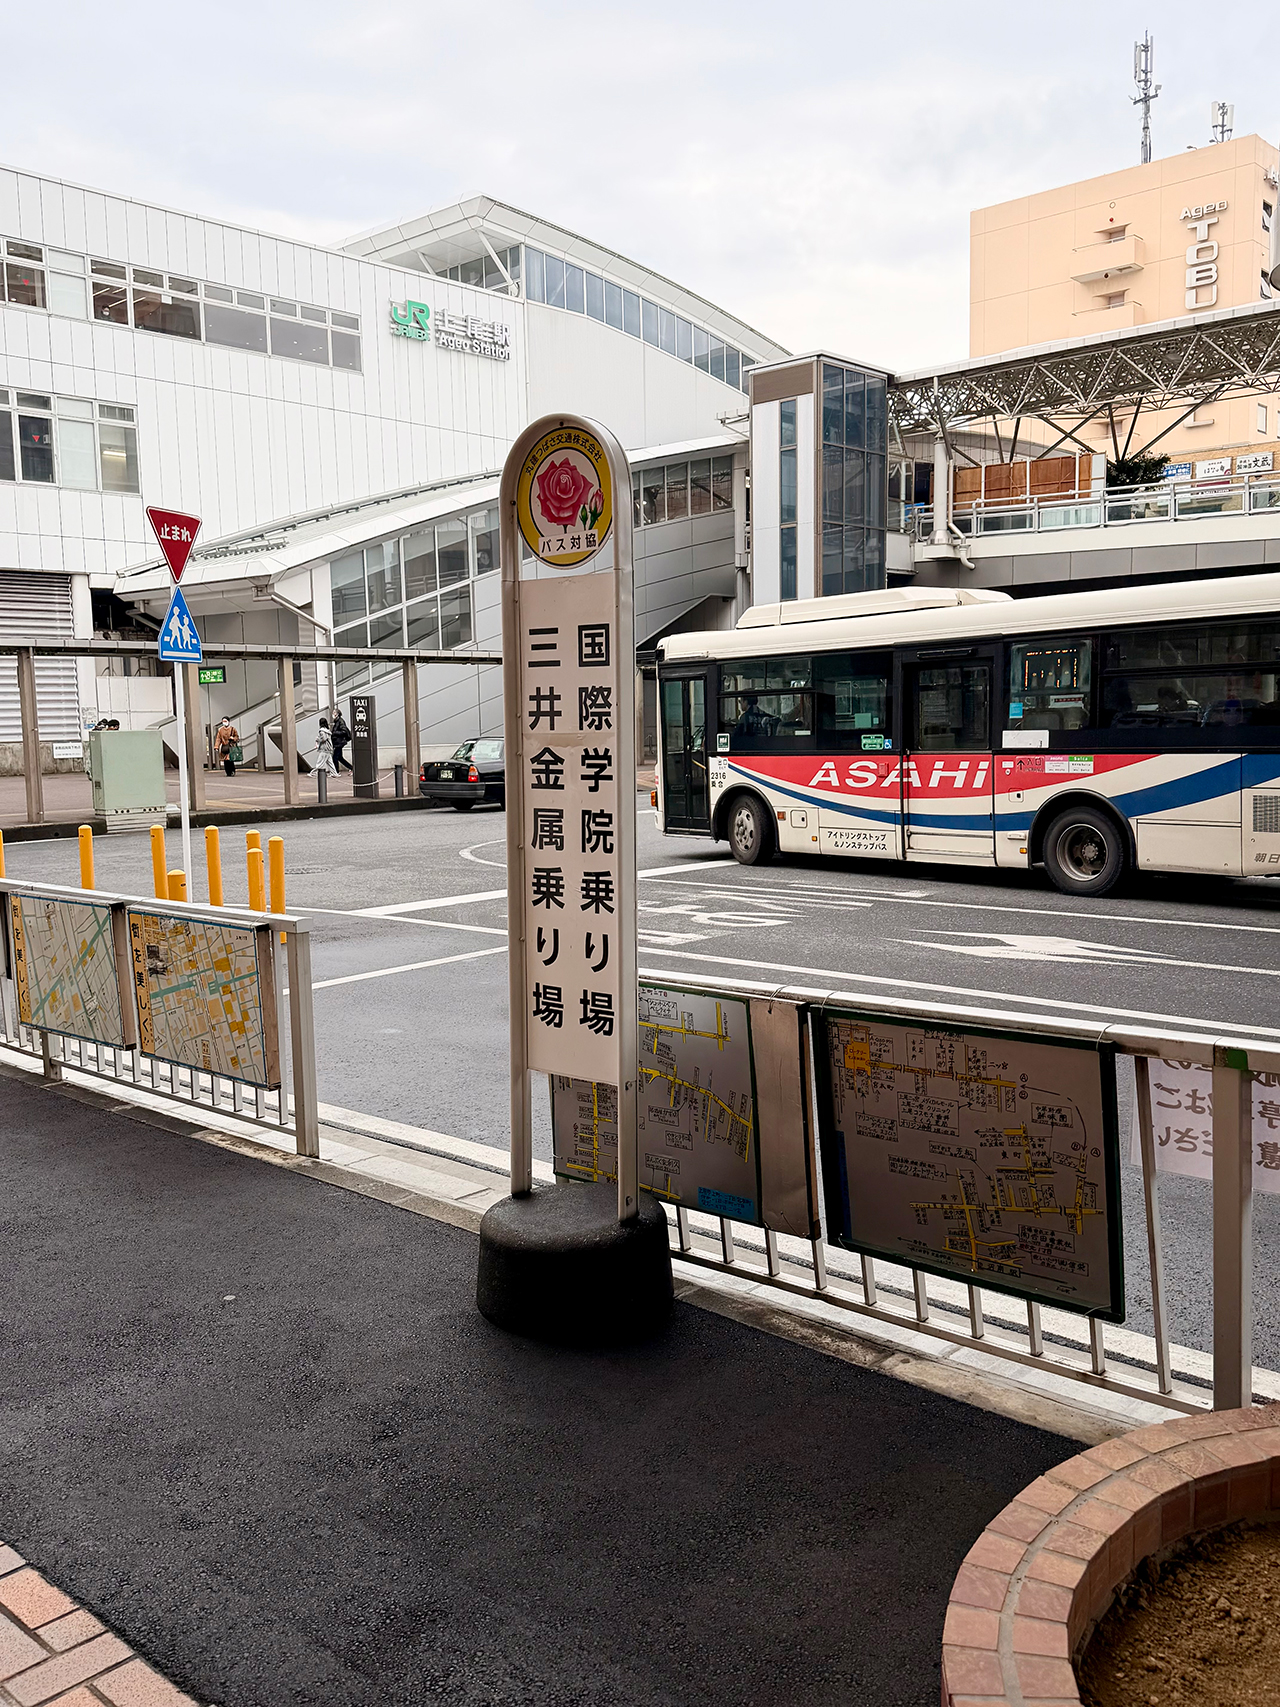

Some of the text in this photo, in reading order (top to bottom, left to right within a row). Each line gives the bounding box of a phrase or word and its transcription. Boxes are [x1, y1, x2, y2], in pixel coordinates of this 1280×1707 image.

[1179, 200, 1228, 220] Ageo
[1185, 216, 1219, 310] TOBU
[393, 300, 430, 331] JR
[438, 308, 511, 347] 上尾駅
[440, 332, 511, 360] Ageo Station
[525, 432, 602, 476] 丸建つばさ交通株式会社
[160, 523, 192, 543] 止まれ
[541, 532, 597, 554] バス対協
[353, 699, 368, 707] TAXI
[710, 772, 727, 781] 2316
[527, 627, 566, 1029] 三井金属乗り場
[577, 623, 615, 1037] 国際学院乗り場
[827, 831, 887, 841] アイドリングストップ
